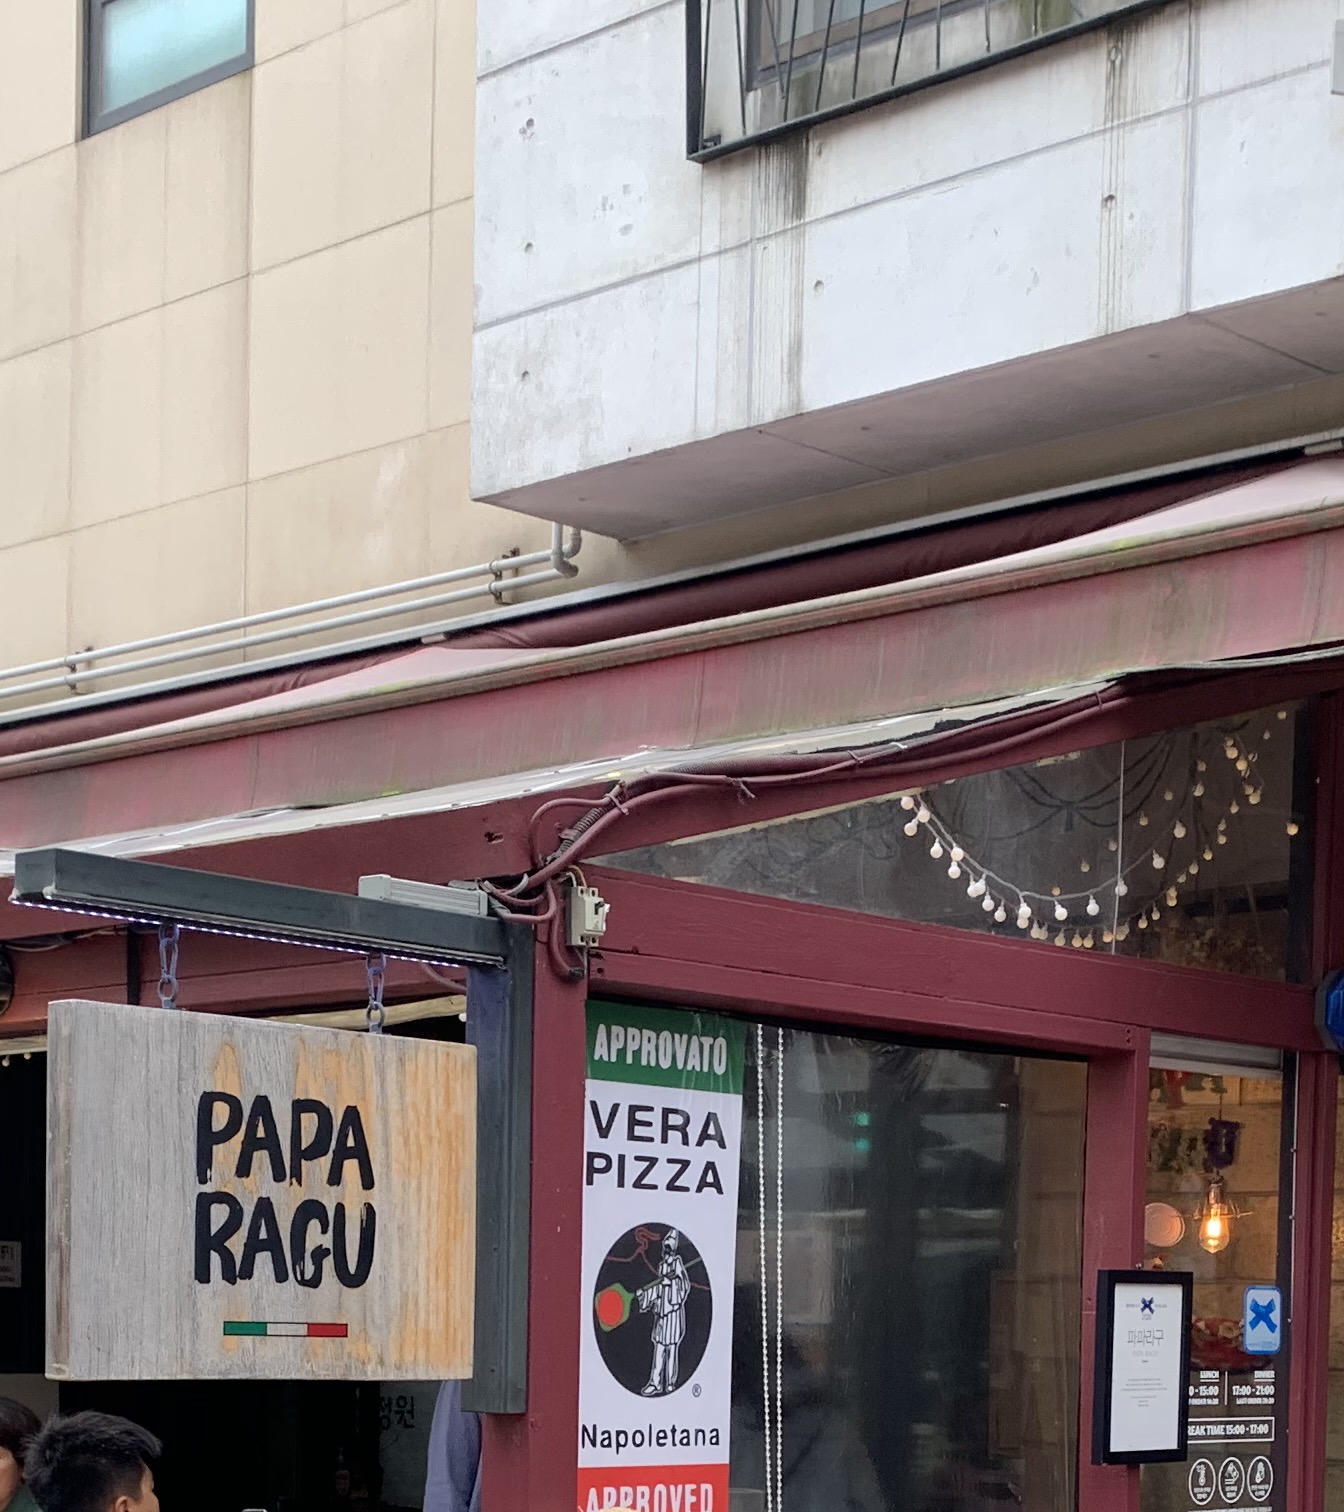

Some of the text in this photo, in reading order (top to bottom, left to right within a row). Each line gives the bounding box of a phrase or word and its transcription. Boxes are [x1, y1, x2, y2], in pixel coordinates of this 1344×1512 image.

[593, 1023, 727, 1076] APPROVATO
[196, 1090, 375, 1190] PAPA
[589, 1099, 727, 1150] VERA
[585, 1151, 724, 1195] PIZZA
[194, 1191, 377, 1288] RAGU
[1232, 1385, 1251, 1396] 17:00
[1256, 1385, 1275, 1396] 21:00
[581, 1423, 720, 1456] Napoletana
[1188, 1425, 1206, 1436] REAK
[1206, 1425, 1225, 1435] TIME
[1226, 1424, 1245, 1435] 15:00
[1250, 1423, 1269, 1434] 17:00
